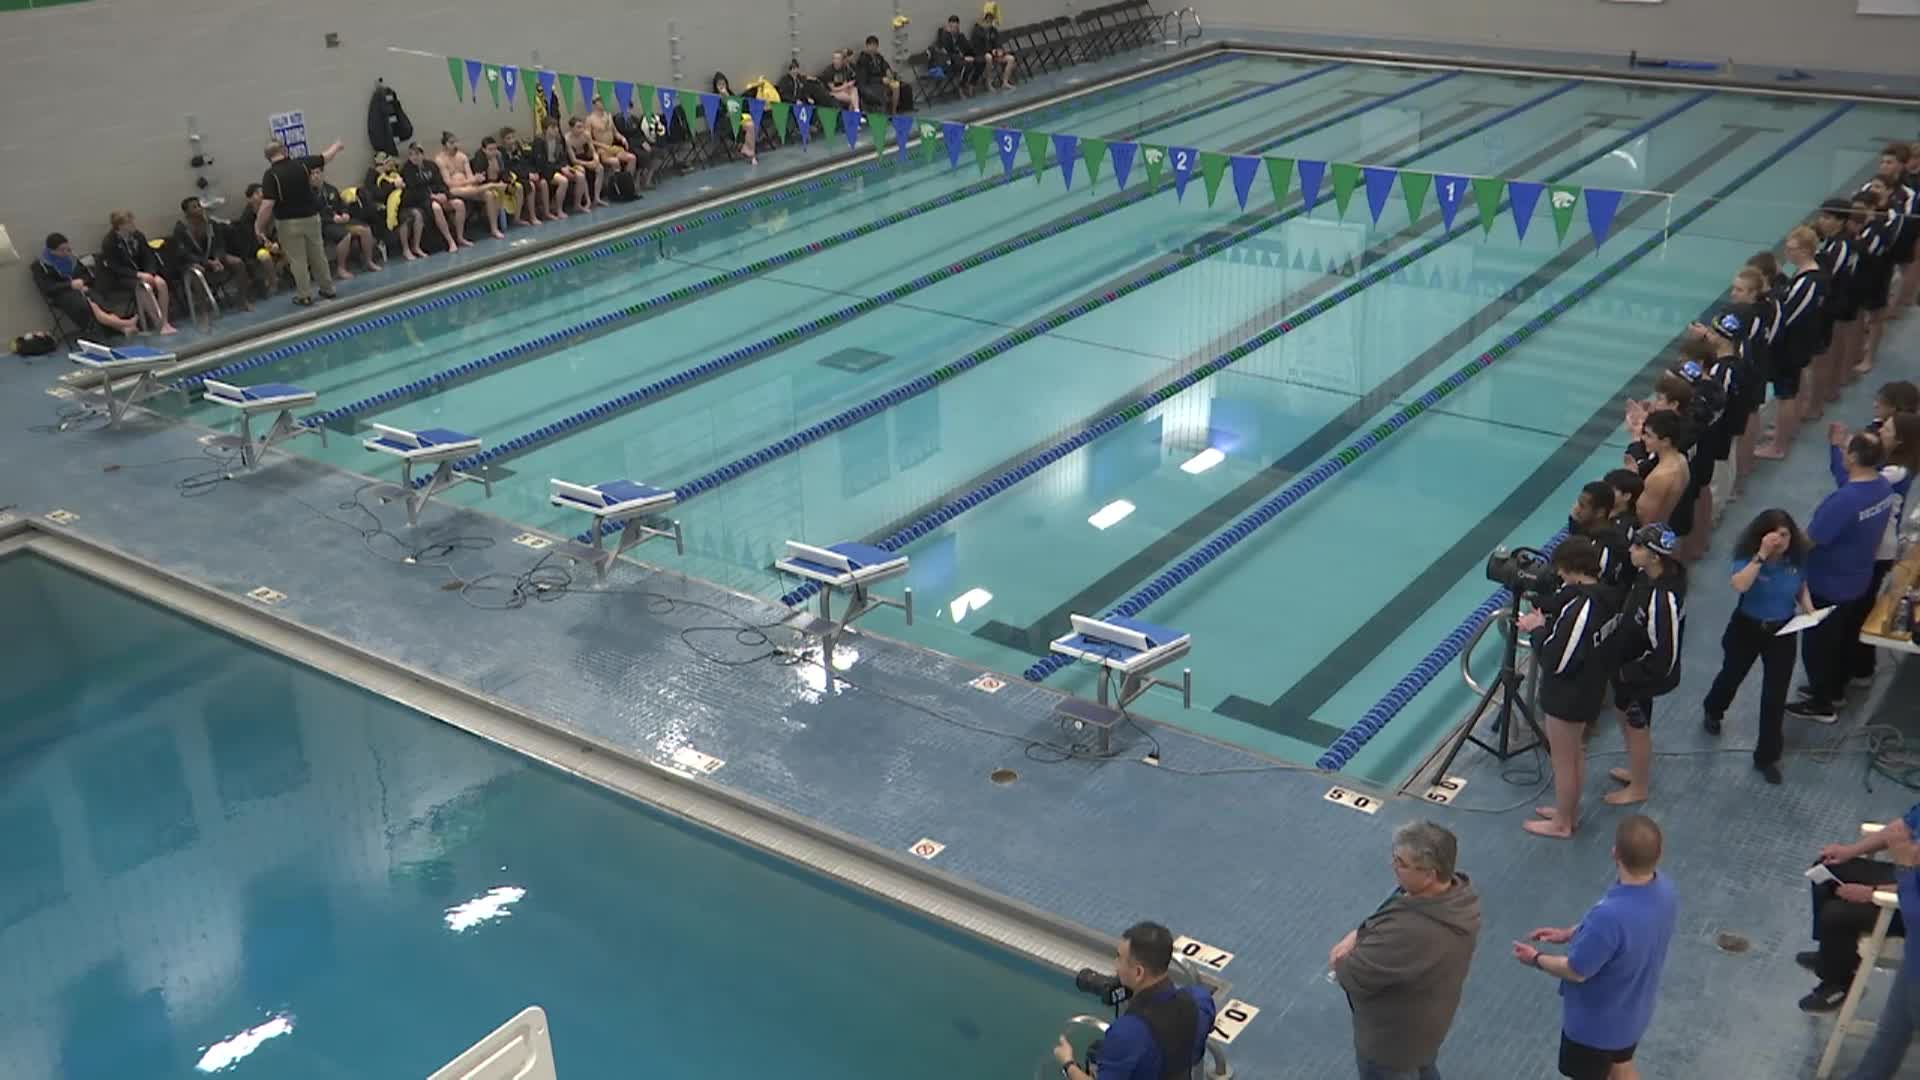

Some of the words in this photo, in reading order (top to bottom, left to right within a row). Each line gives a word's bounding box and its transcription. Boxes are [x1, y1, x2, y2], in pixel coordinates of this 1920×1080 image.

[663, 92, 671, 108] 5
[799, 107, 807, 123] 4
[1003, 135, 1012, 152] 3
[1176, 151, 1188, 170] 2
[1445, 181, 1455, 201] 1
